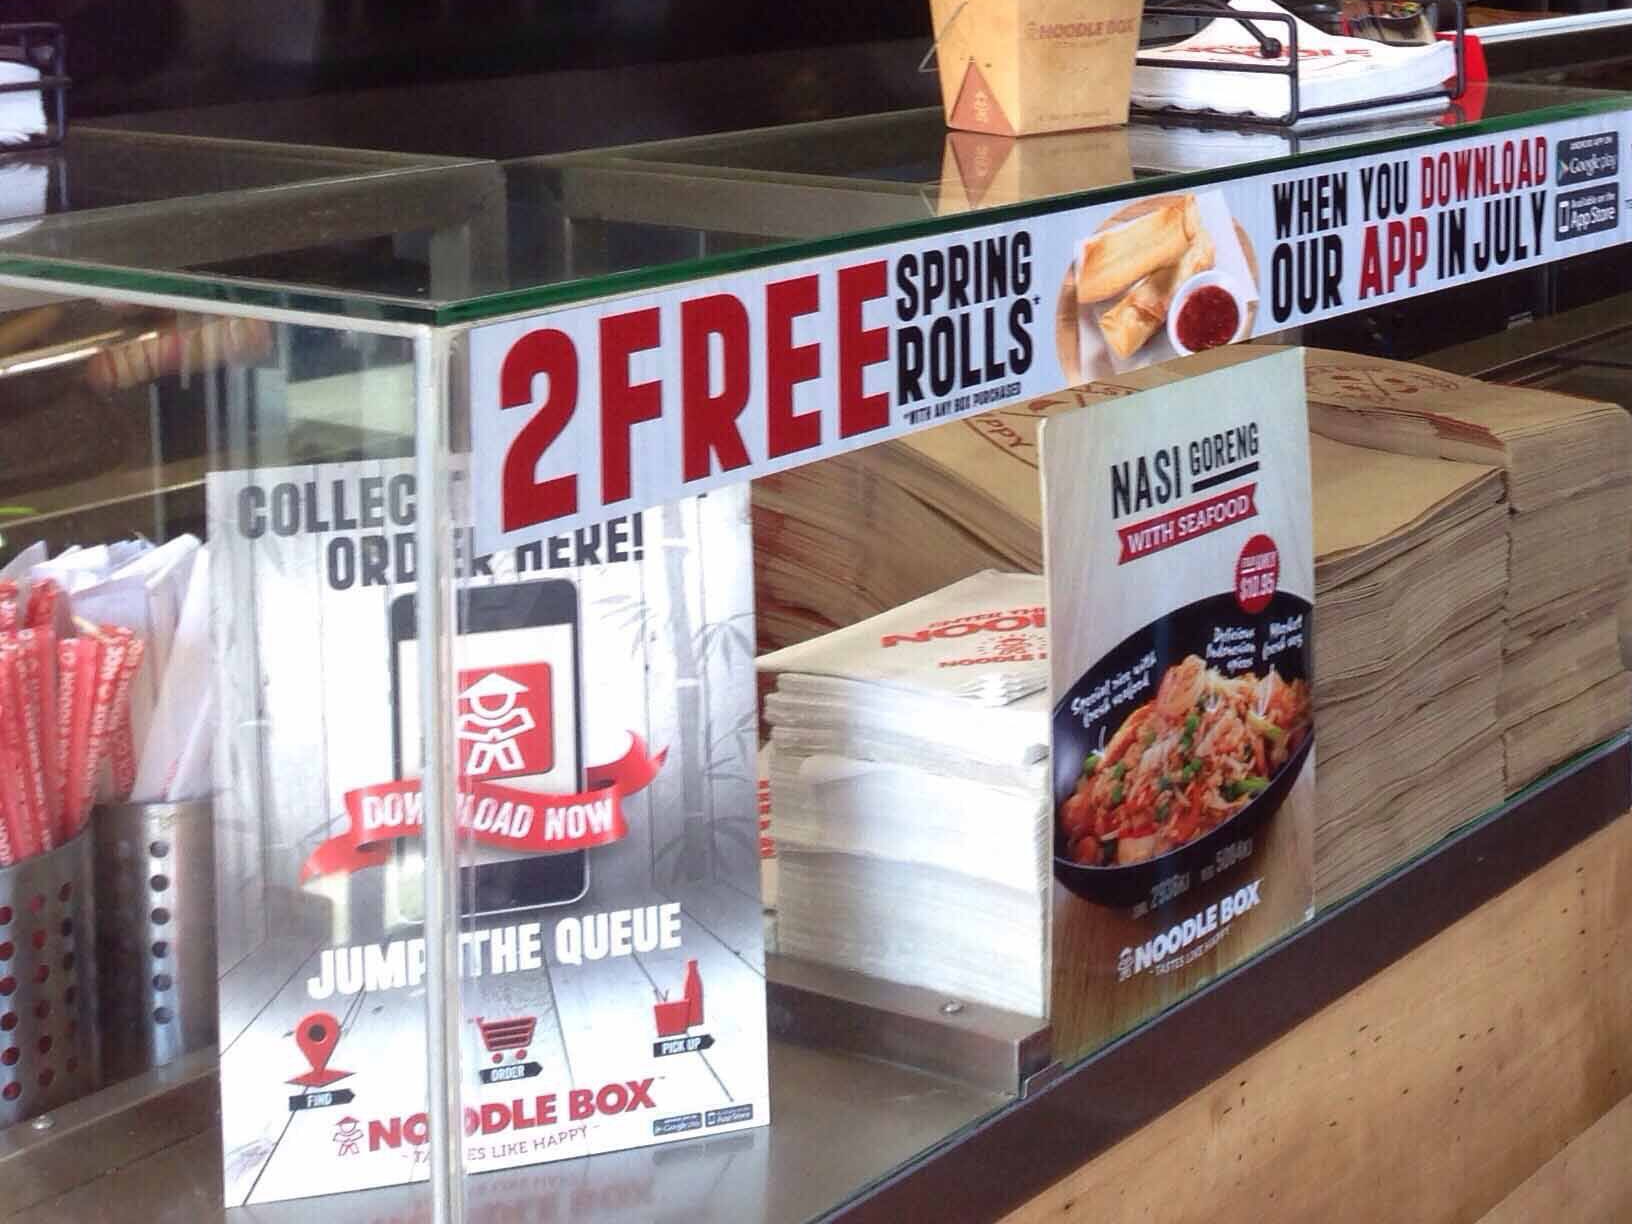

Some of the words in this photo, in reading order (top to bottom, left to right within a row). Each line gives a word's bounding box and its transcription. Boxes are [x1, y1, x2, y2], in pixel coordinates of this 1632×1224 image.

[1038, 21, 1104, 40] NOODLE
[1272, 171, 1348, 241] WHEN
[1358, 160, 1409, 222] YOU
[1420, 135, 1548, 210] DOWNLOAD
[895, 230, 1033, 323] SPRING
[1271, 233, 1343, 324] OUR
[1357, 216, 1429, 301] APP
[1436, 207, 1467, 281] IN
[1473, 190, 1547, 274] JULY
[933, 401, 952, 419] ANY
[954, 395, 971, 413] BOX
[972, 381, 1022, 408] PURCHASED
[1110, 445, 1183, 520] NASI
[1188, 422, 1260, 478] GORENG
[236, 472, 418, 540] COLLEC
[1126, 525, 1176, 555] WITH
[1177, 493, 1250, 536] SEAFOOD
[543, 796, 615, 842] NOW
[307, 937, 426, 1000] JUMP
[463, 922, 542, 977] THE
[554, 902, 682, 967] QUEUE
[1133, 903, 1219, 975] NOODLE
[1219, 879, 1262, 926] BOX
[489, 1063, 526, 1082] ORDER
[661, 1038, 686, 1055] PICK
[687, 1036, 703, 1052] UP
[305, 1092, 333, 1107] FIND
[567, 1076, 657, 1122] BOX
[413, 1147, 487, 1165] TAES
[491, 1140, 528, 1159] LIKE
[533, 1125, 590, 1152] HAPPY
